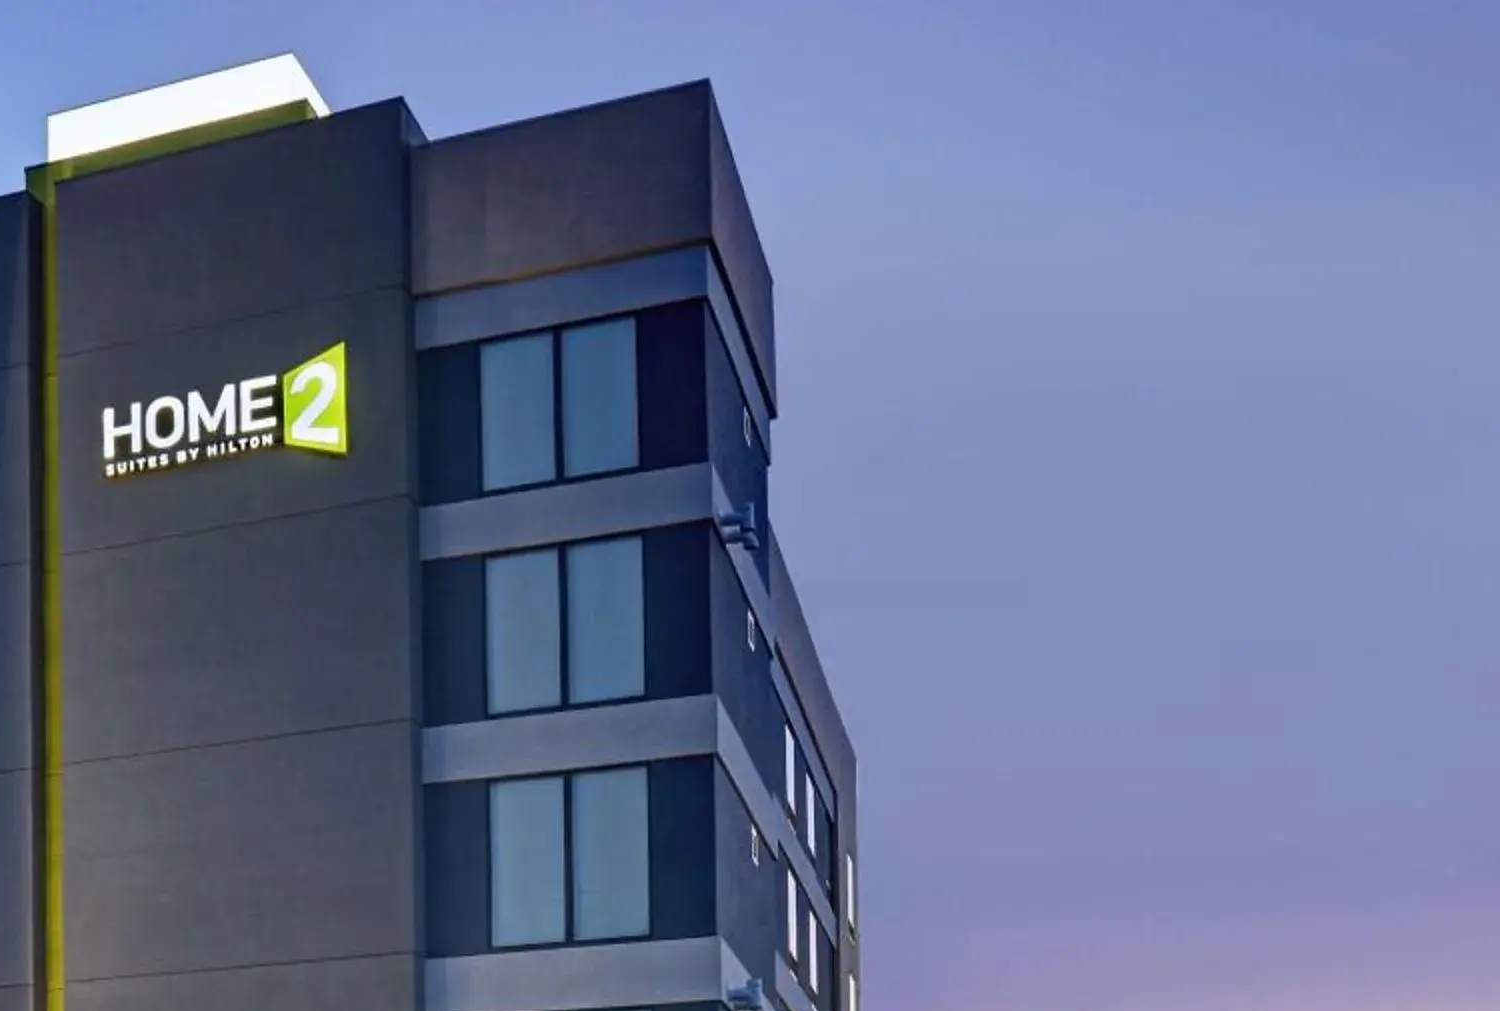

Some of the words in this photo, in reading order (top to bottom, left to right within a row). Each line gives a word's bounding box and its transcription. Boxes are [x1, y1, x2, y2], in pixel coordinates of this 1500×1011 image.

[105, 453, 169, 477] SUITES
[176, 447, 200, 464] BY
[206, 433, 274, 458] HILTON
